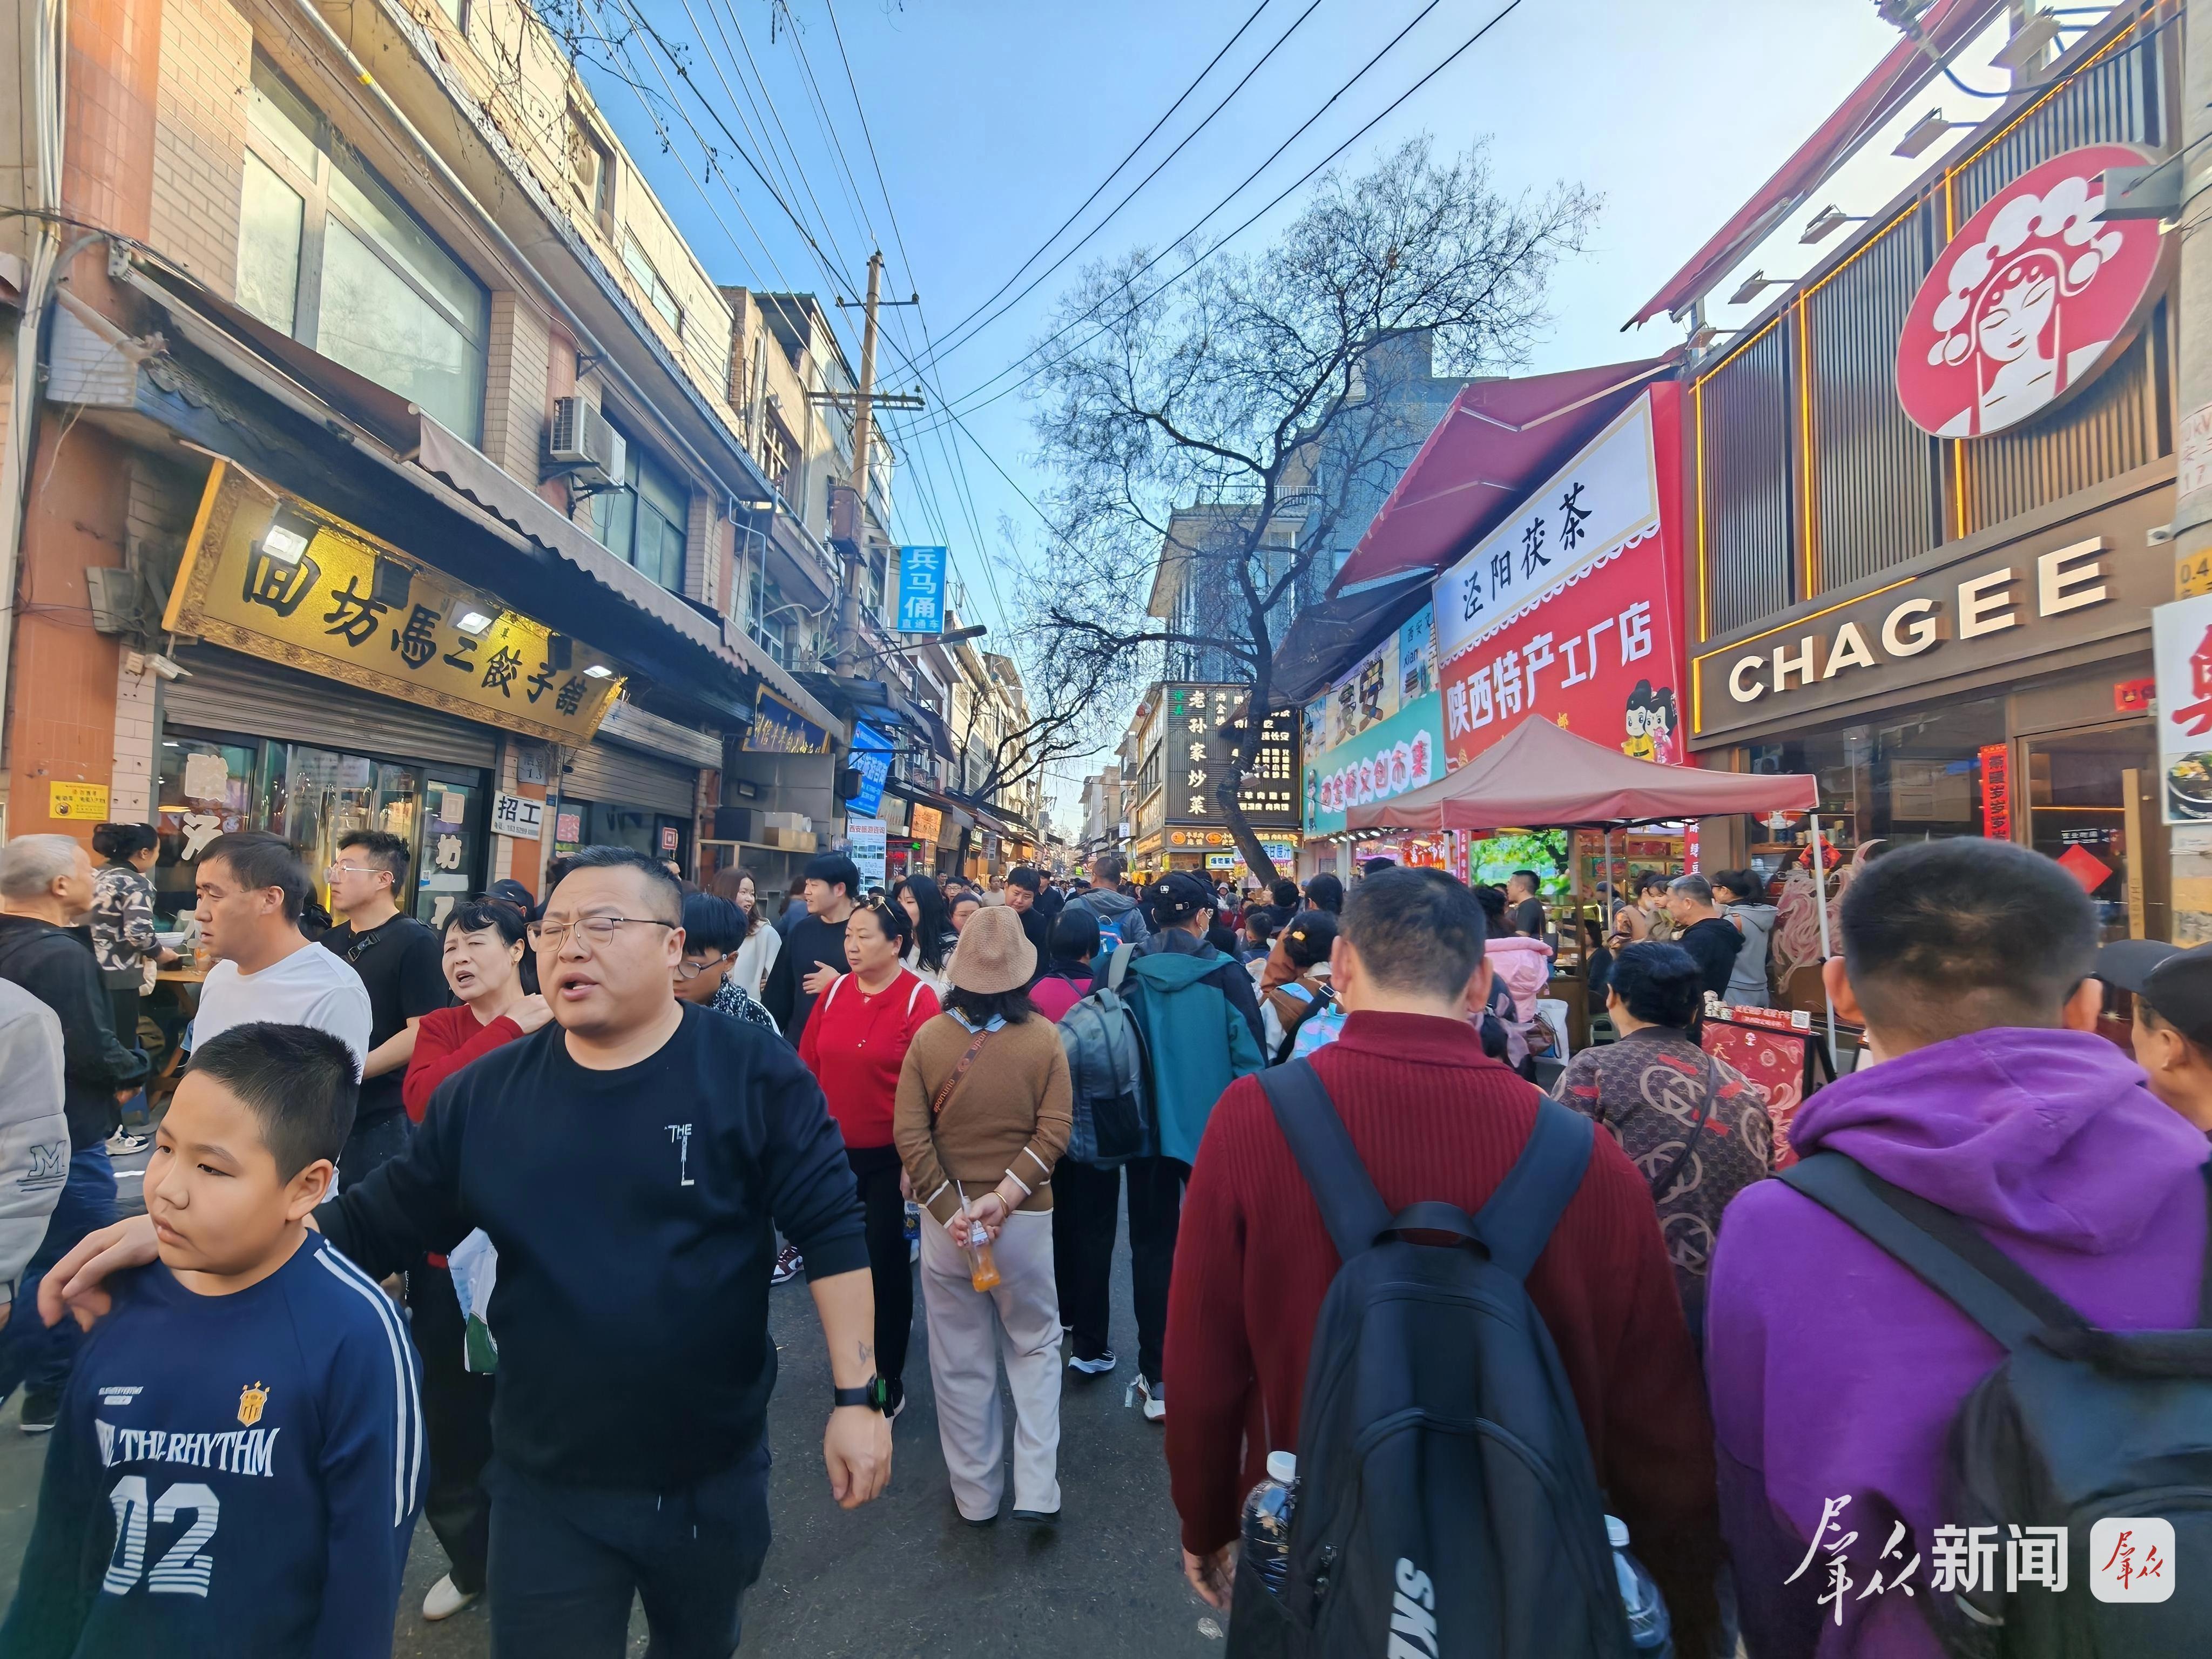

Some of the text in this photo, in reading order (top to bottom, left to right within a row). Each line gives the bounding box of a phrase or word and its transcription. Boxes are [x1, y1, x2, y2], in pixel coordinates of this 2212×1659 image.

[904, 548, 939, 618] 兵马俑
[1463, 482, 1593, 622] 泾阳茯茶
[901, 619, 940, 629] 直通车
[1446, 601, 1653, 740] 陕西特产工厂店
[1729, 535, 2108, 703] CHAGEE
[498, 795, 541, 825] 招工
[1188, 690, 1208, 815] 老孙家炒菜
[165, 1427, 281, 1477] RHYTHM
[103, 1475, 220, 1598] 02
